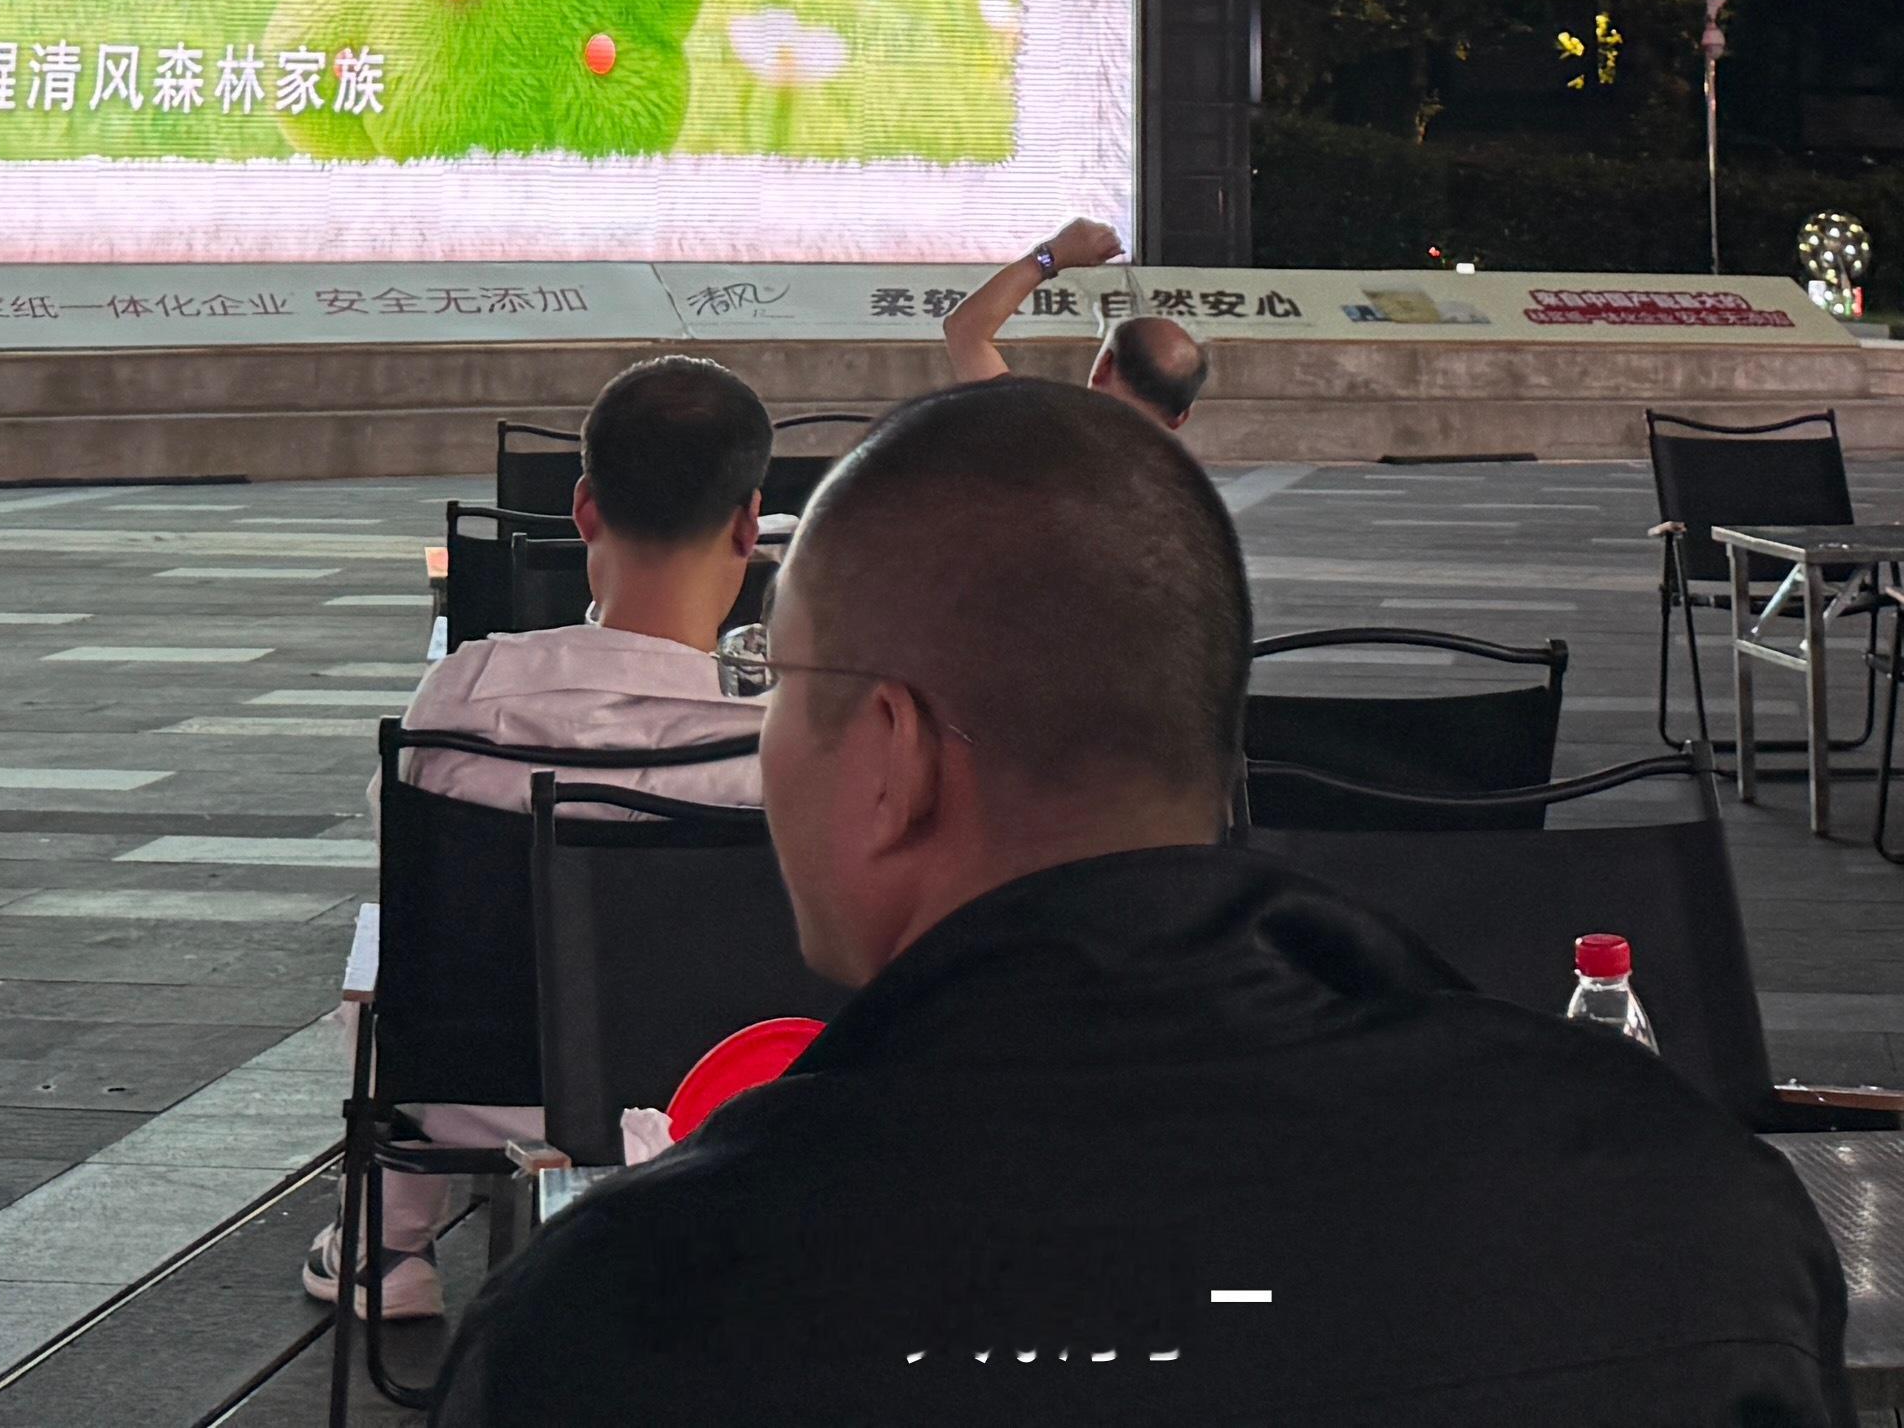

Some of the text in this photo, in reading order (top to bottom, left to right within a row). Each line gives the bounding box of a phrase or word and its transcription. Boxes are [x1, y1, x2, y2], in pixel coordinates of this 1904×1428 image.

[315, 286, 589, 315] 安全无添加
[687, 282, 791, 318] 清风
[869, 287, 1081, 319] 柔软肤
